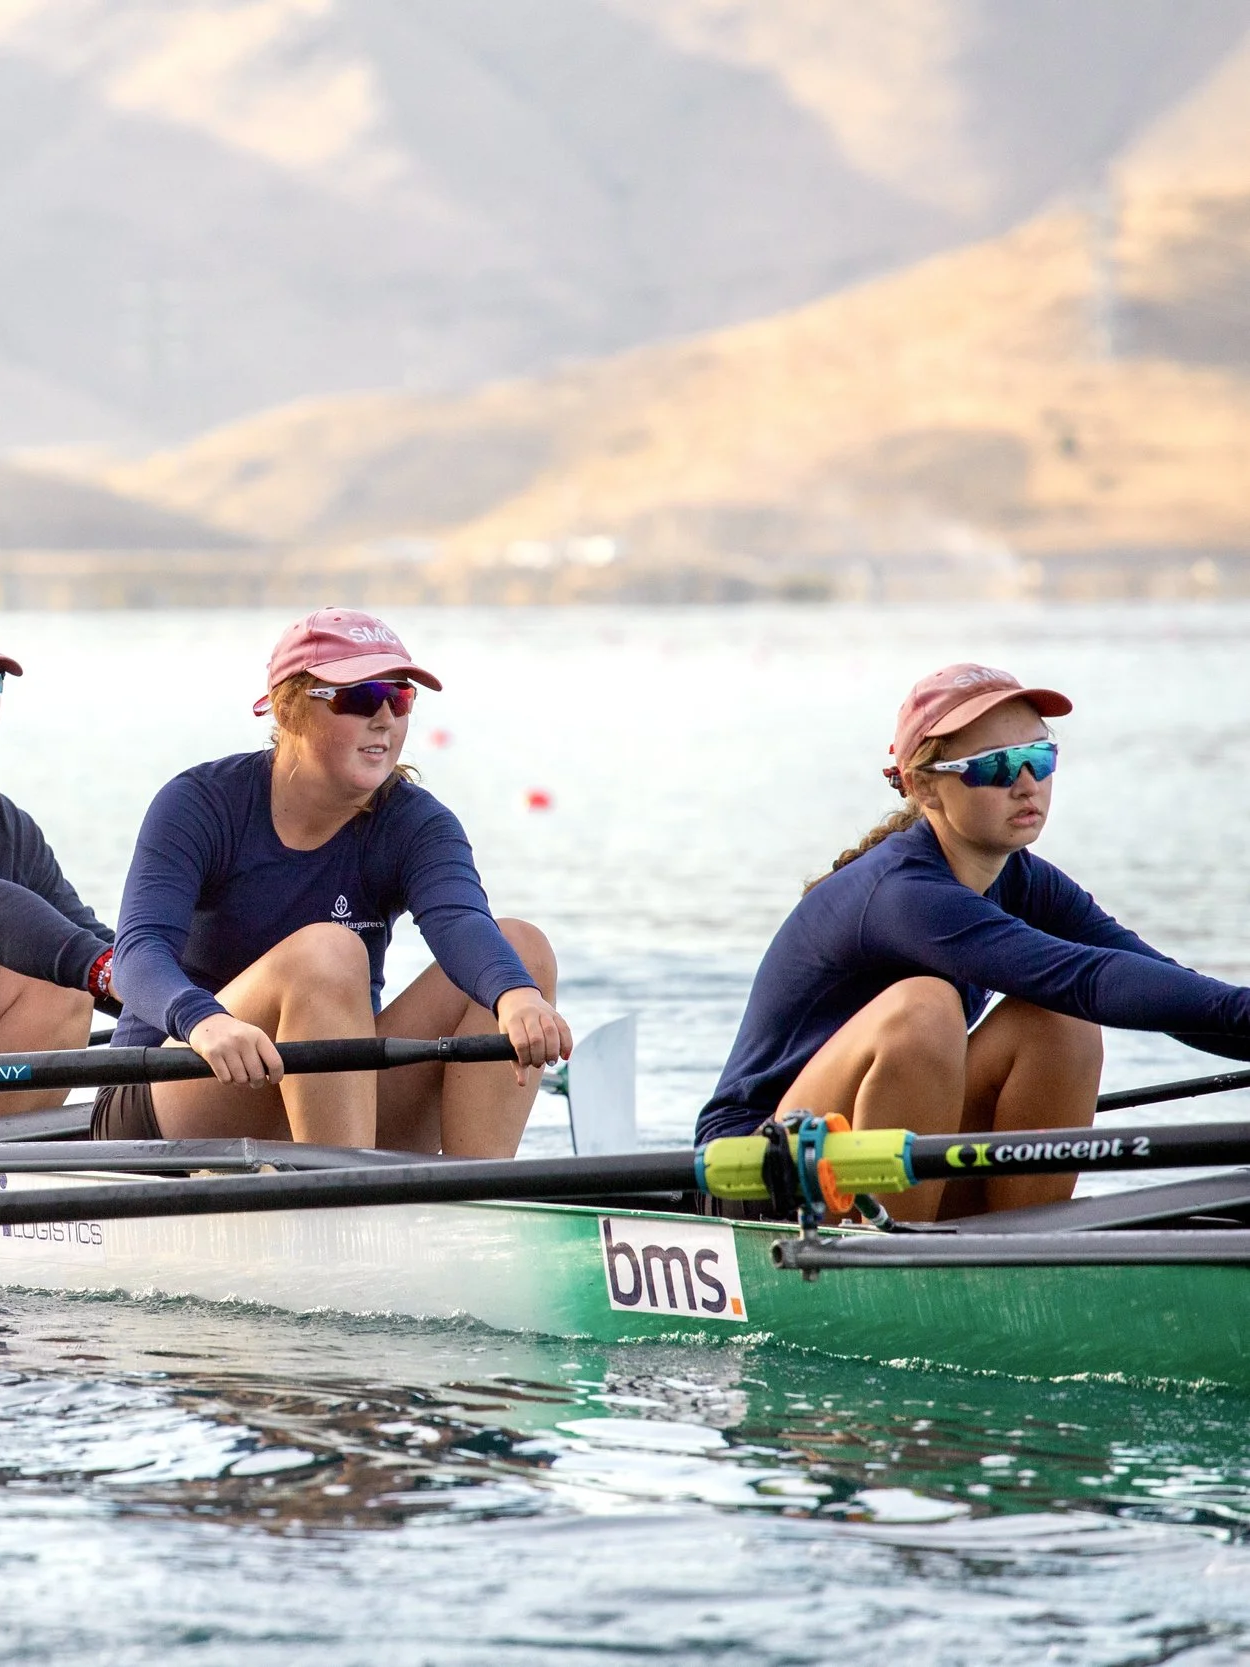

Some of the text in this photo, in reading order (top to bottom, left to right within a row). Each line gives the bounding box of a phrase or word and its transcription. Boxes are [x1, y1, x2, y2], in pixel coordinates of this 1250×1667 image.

[349, 626, 397, 644] SMC
[994, 1136, 1150, 1161] concept 2
[13, 1220, 103, 1245] LOGISTICS
